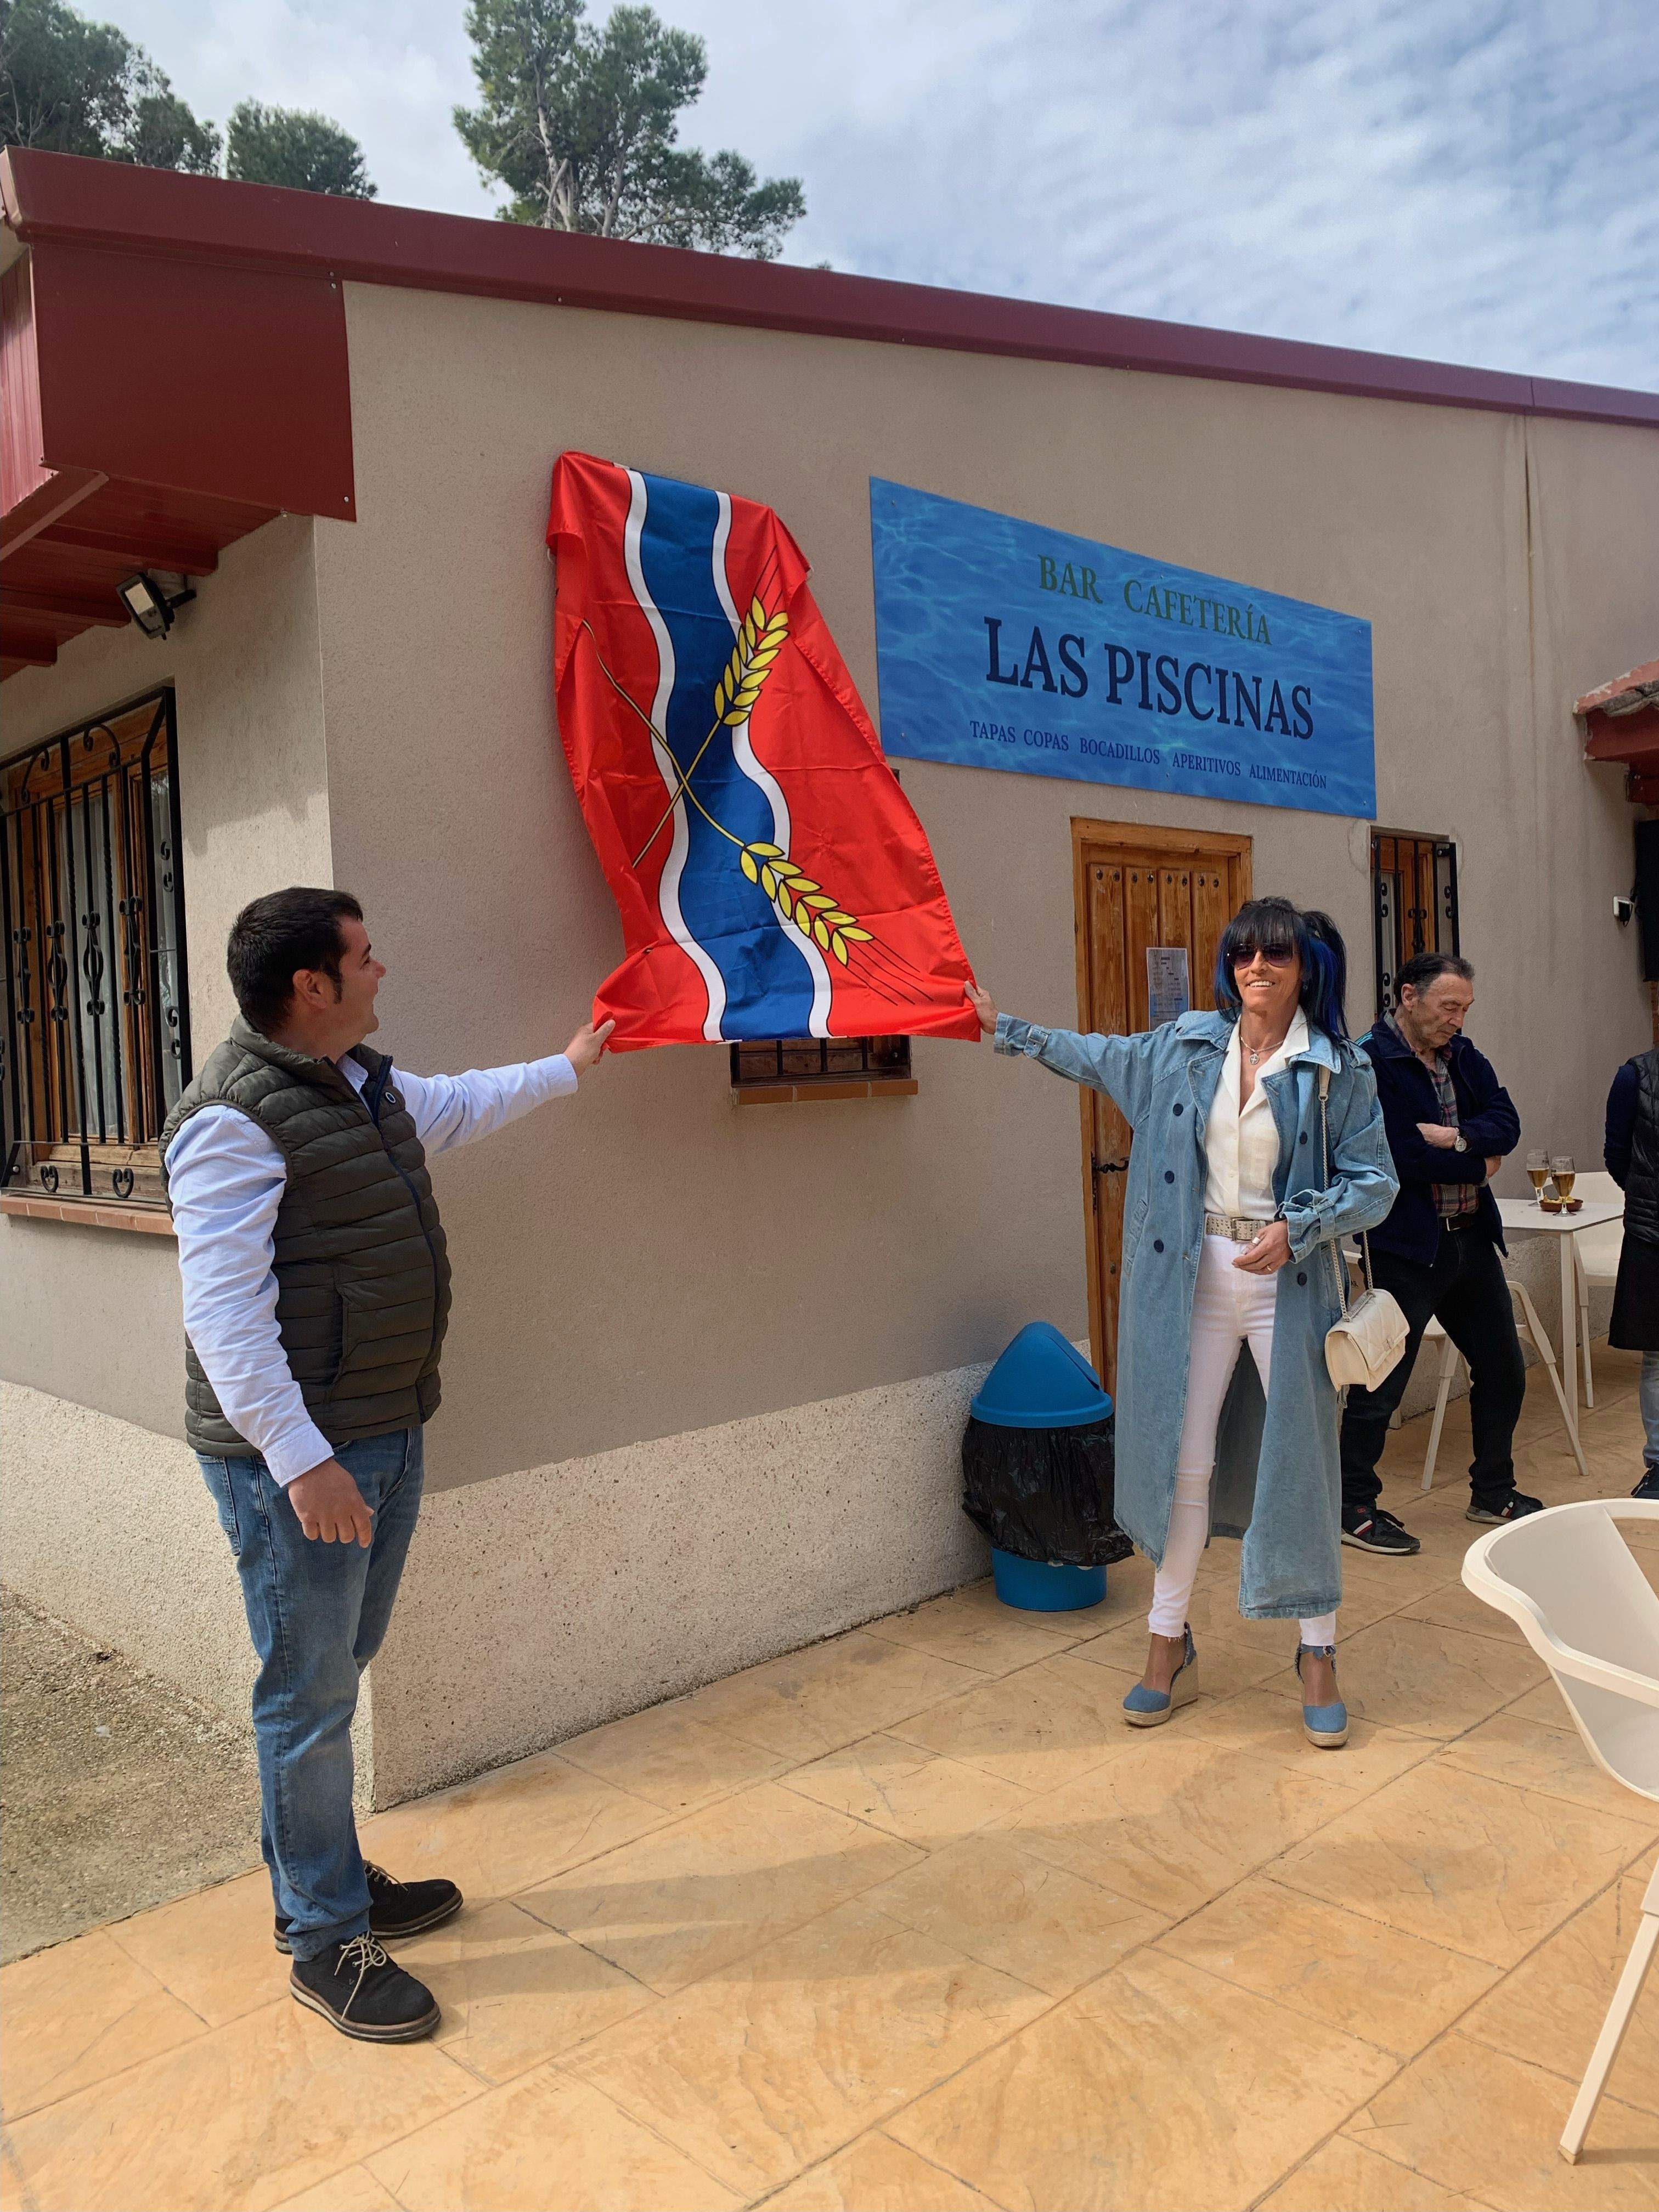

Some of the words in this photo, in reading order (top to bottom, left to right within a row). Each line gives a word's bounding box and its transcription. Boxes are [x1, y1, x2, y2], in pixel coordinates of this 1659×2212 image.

[1037, 554, 1103, 604] BAR
[1123, 579, 1272, 646] CAFETERÍA
[984, 616, 1088, 698] LAS
[1104, 642, 1314, 740] PISCINAS
[969, 720, 1016, 743] TAPAS
[1023, 729, 1069, 752] COPAS
[1079, 737, 1160, 765] BOCADILLOS
[1172, 752, 1242, 776] APERITIVOS
[1249, 763, 1327, 789] ALIMENTACIÓN
